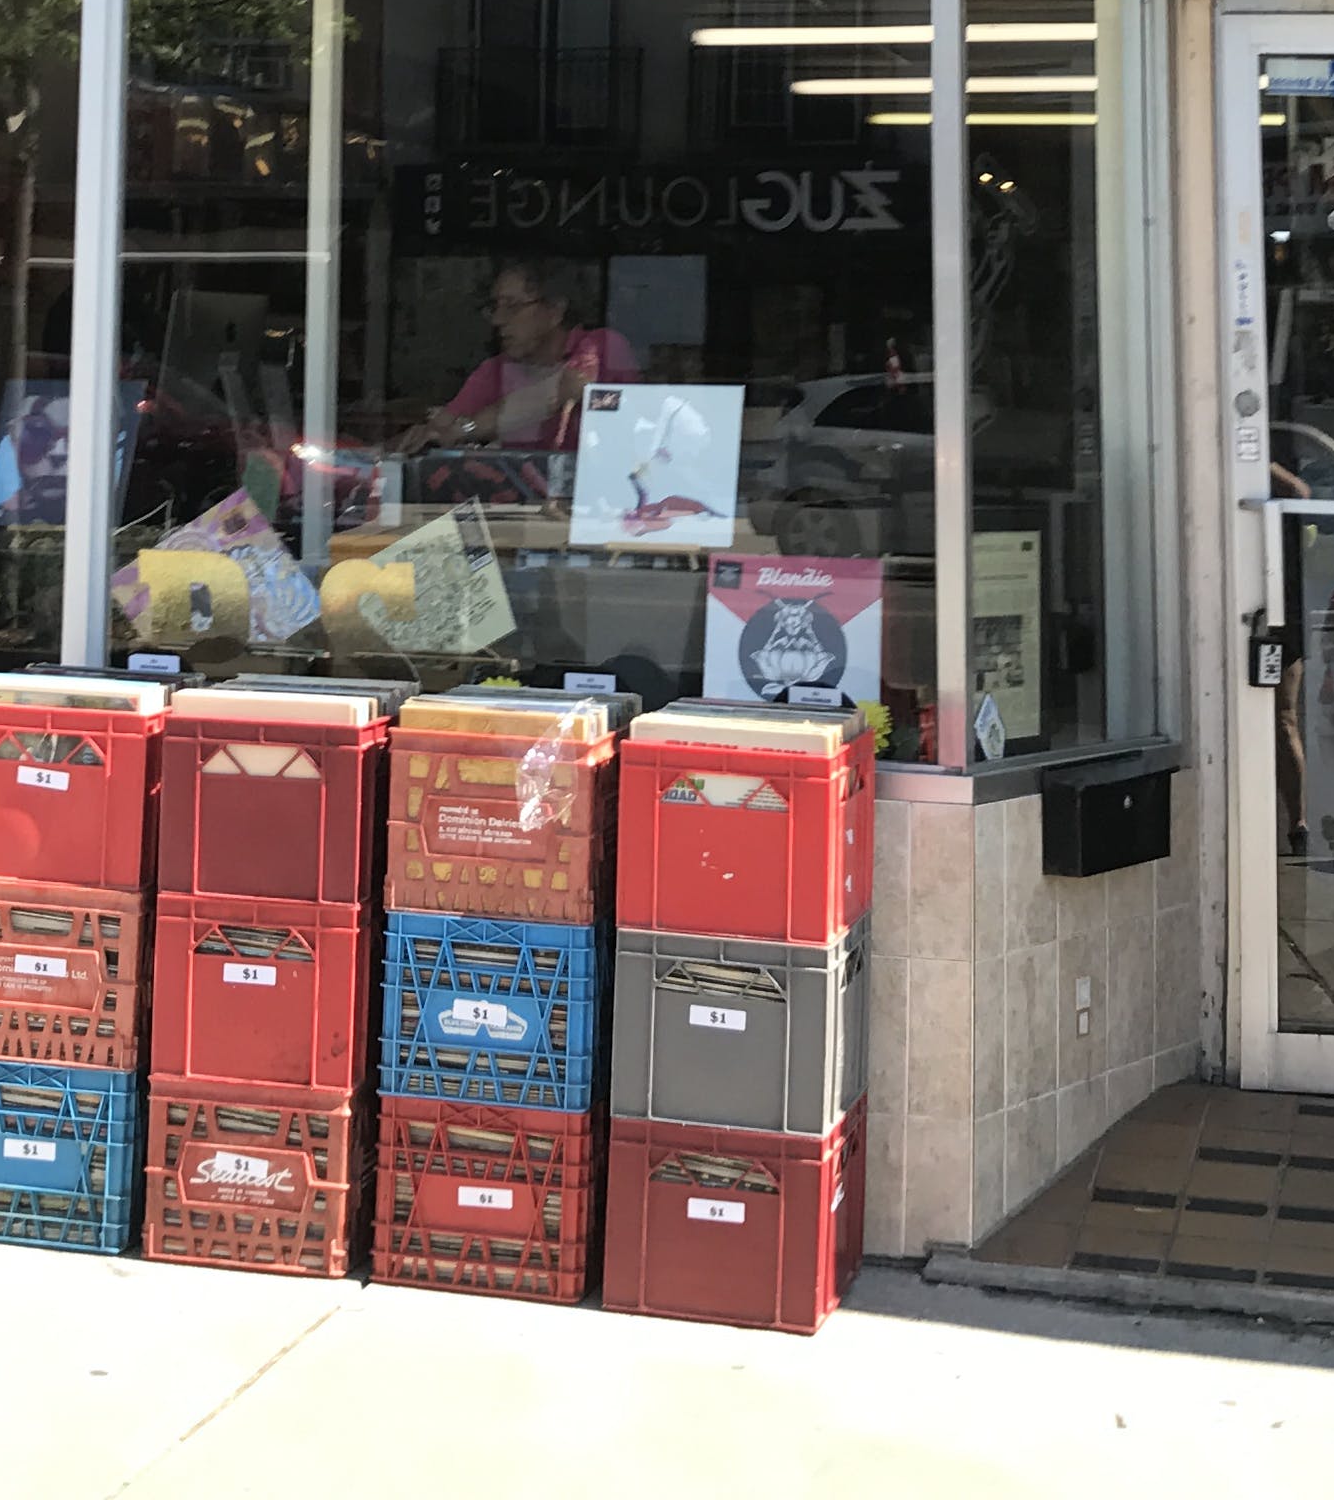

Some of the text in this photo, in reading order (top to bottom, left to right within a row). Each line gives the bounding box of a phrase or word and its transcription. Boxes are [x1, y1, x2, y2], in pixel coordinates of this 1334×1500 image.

[755, 567, 835, 588] Blondie
[36, 771, 52, 784] $1
[438, 814, 486, 827] Dominion
[34, 962, 48, 972] $1
[71, 970, 89, 981] Ltd.
[242, 968, 259, 980] $1
[472, 1007, 488, 1019] $1
[709, 1011, 726, 1024] $1
[22, 1143, 38, 1155] $1
[234, 1159, 249, 1171] $1
[479, 1193, 493, 1204] $1
[709, 1206, 724, 1217] $1
